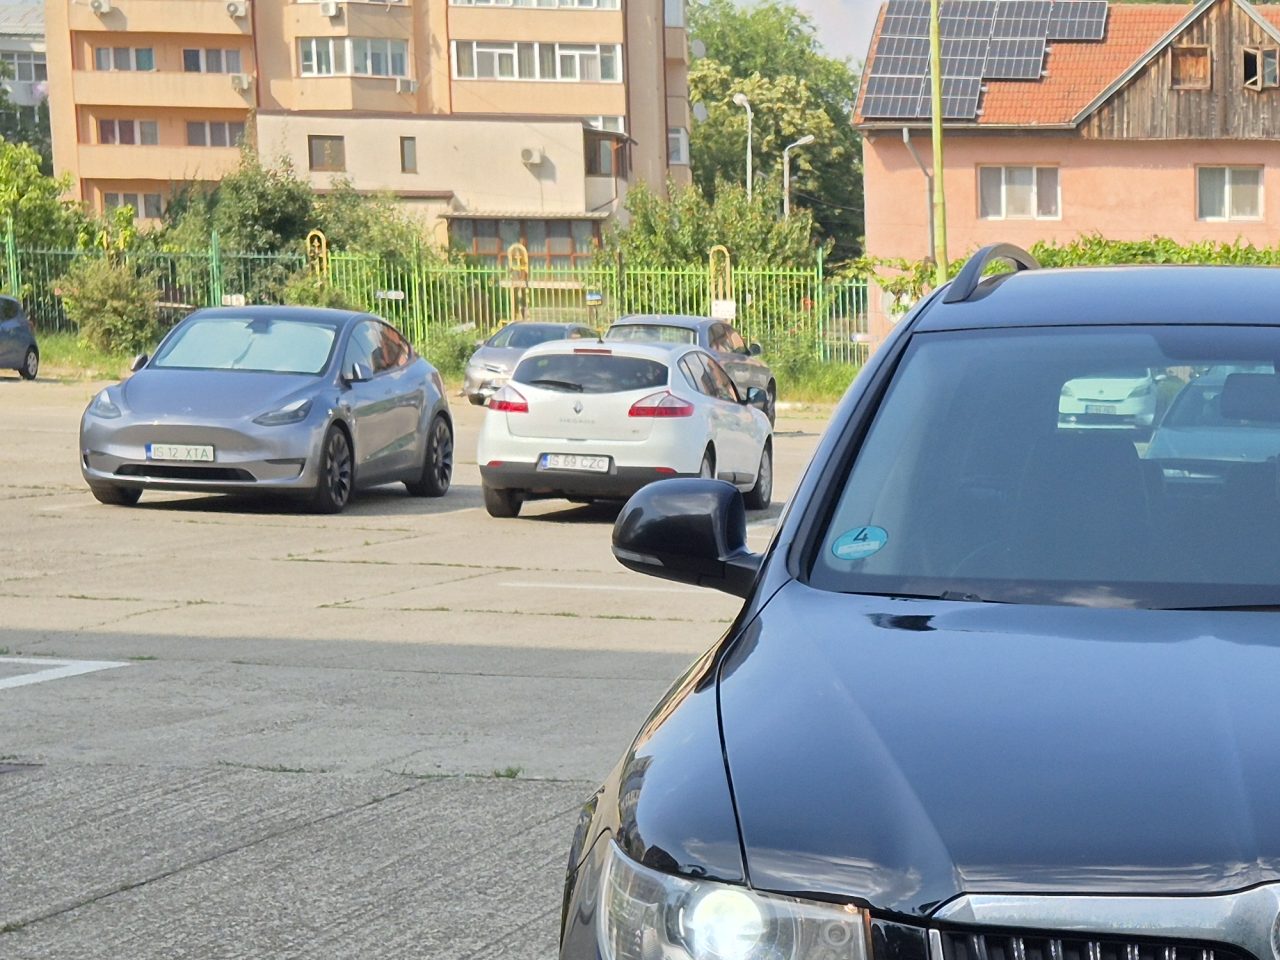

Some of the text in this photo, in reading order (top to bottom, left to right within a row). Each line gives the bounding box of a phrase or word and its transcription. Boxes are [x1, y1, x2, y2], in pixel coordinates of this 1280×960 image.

[153, 446, 209, 459] IS 12 XTA
[853, 527, 869, 542] 4
